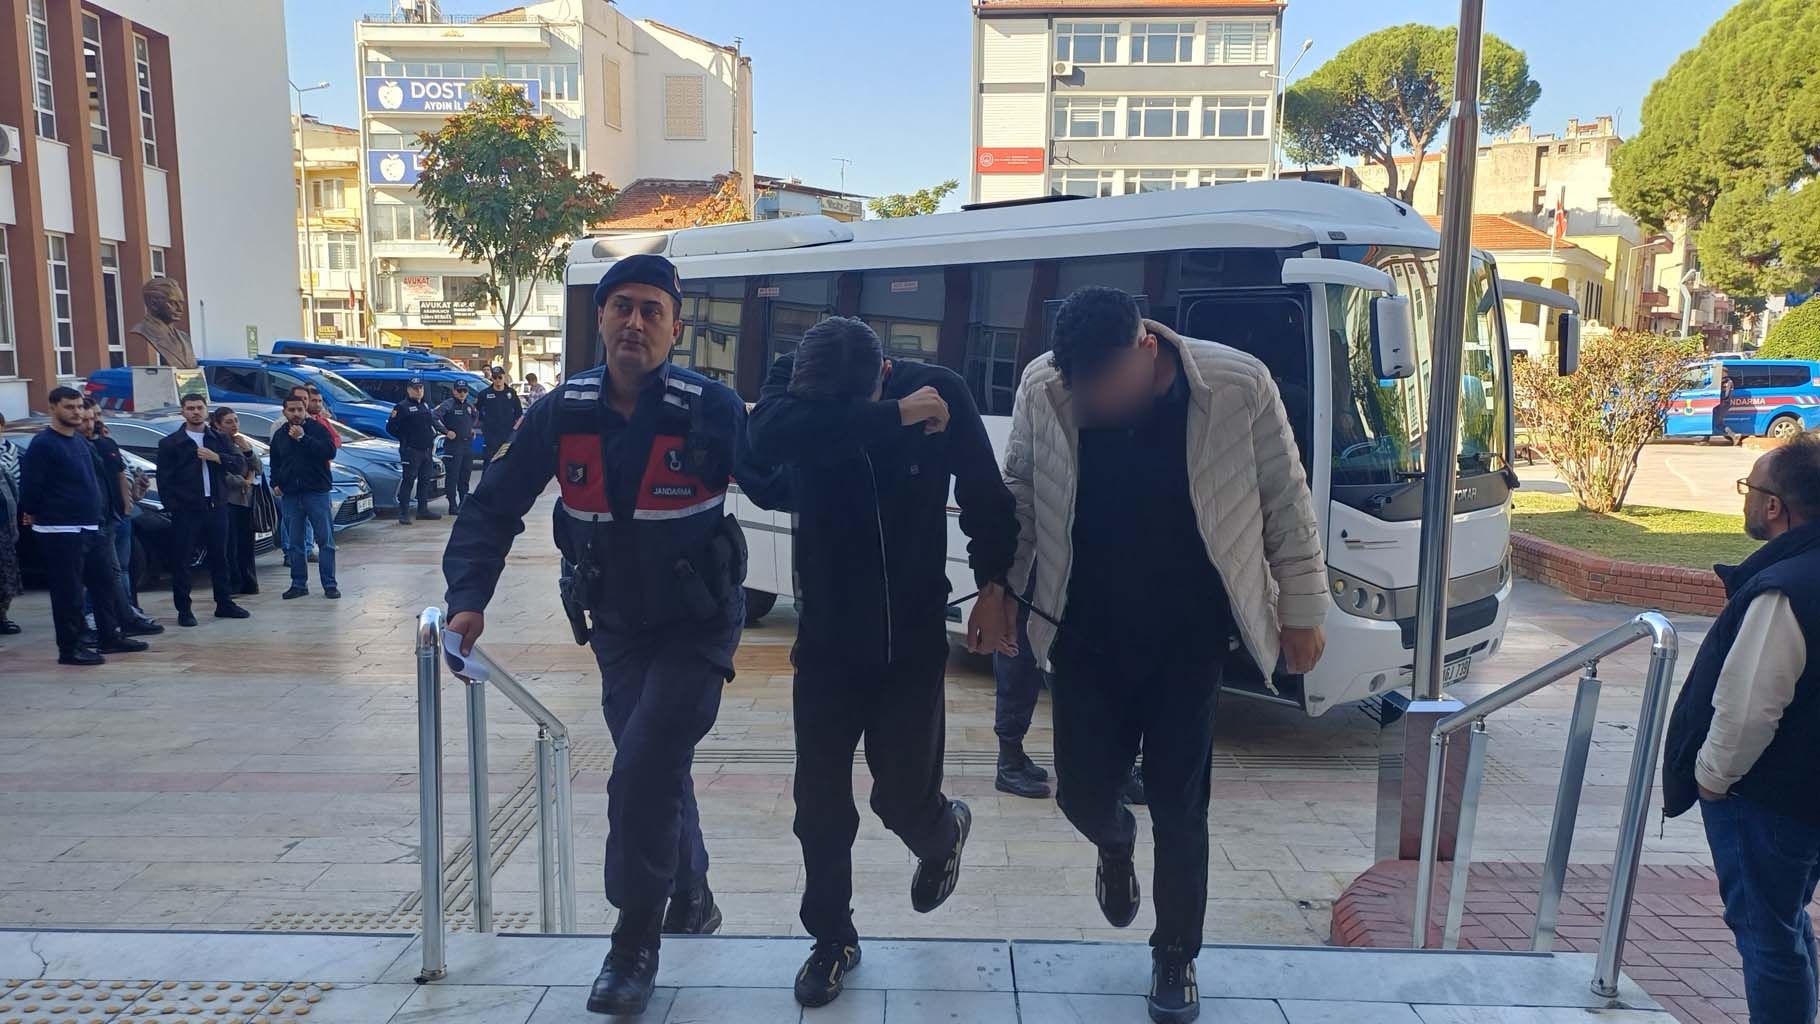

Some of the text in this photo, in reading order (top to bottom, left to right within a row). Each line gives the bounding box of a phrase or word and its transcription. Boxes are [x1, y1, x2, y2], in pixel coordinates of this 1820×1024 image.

[411, 82, 466, 99] DOST
[424, 101, 452, 111] AYDIN
[454, 100, 463, 111] İL
[1730, 398, 1765, 406] NDARMA
[654, 487, 692, 496] JANDARMA
